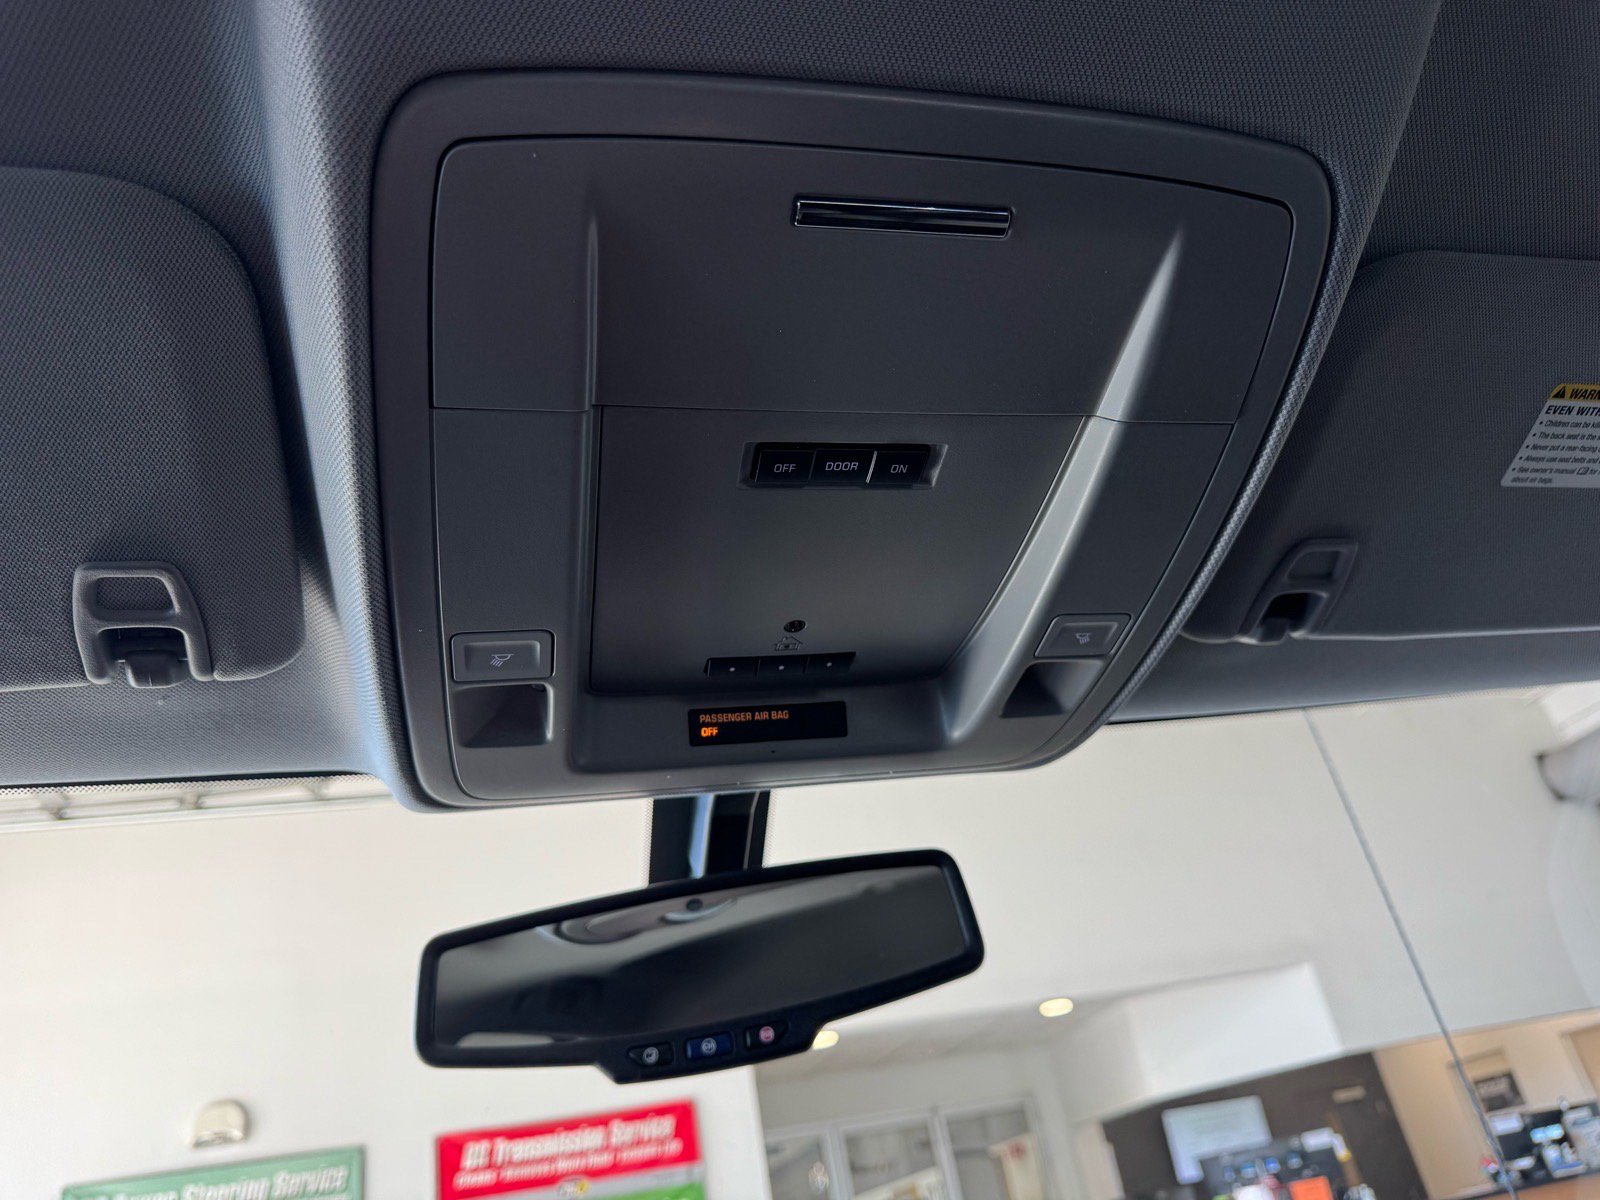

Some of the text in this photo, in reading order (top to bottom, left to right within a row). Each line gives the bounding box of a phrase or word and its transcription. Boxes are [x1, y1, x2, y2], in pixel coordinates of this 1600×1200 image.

[1545, 405, 1575, 415] EVEN
[1544, 420, 1569, 428] Children
[1566, 445, 1597, 453] rear-facing
[774, 464, 796, 473] OFF
[825, 461, 858, 471] DOOR
[890, 464, 908, 473] ON
[700, 710, 789, 723] PASSENGER AIR BAG
[701, 726, 719, 737] OFF
[492, 1123, 606, 1164] Transmission
[272, 1164, 348, 1199] Service
